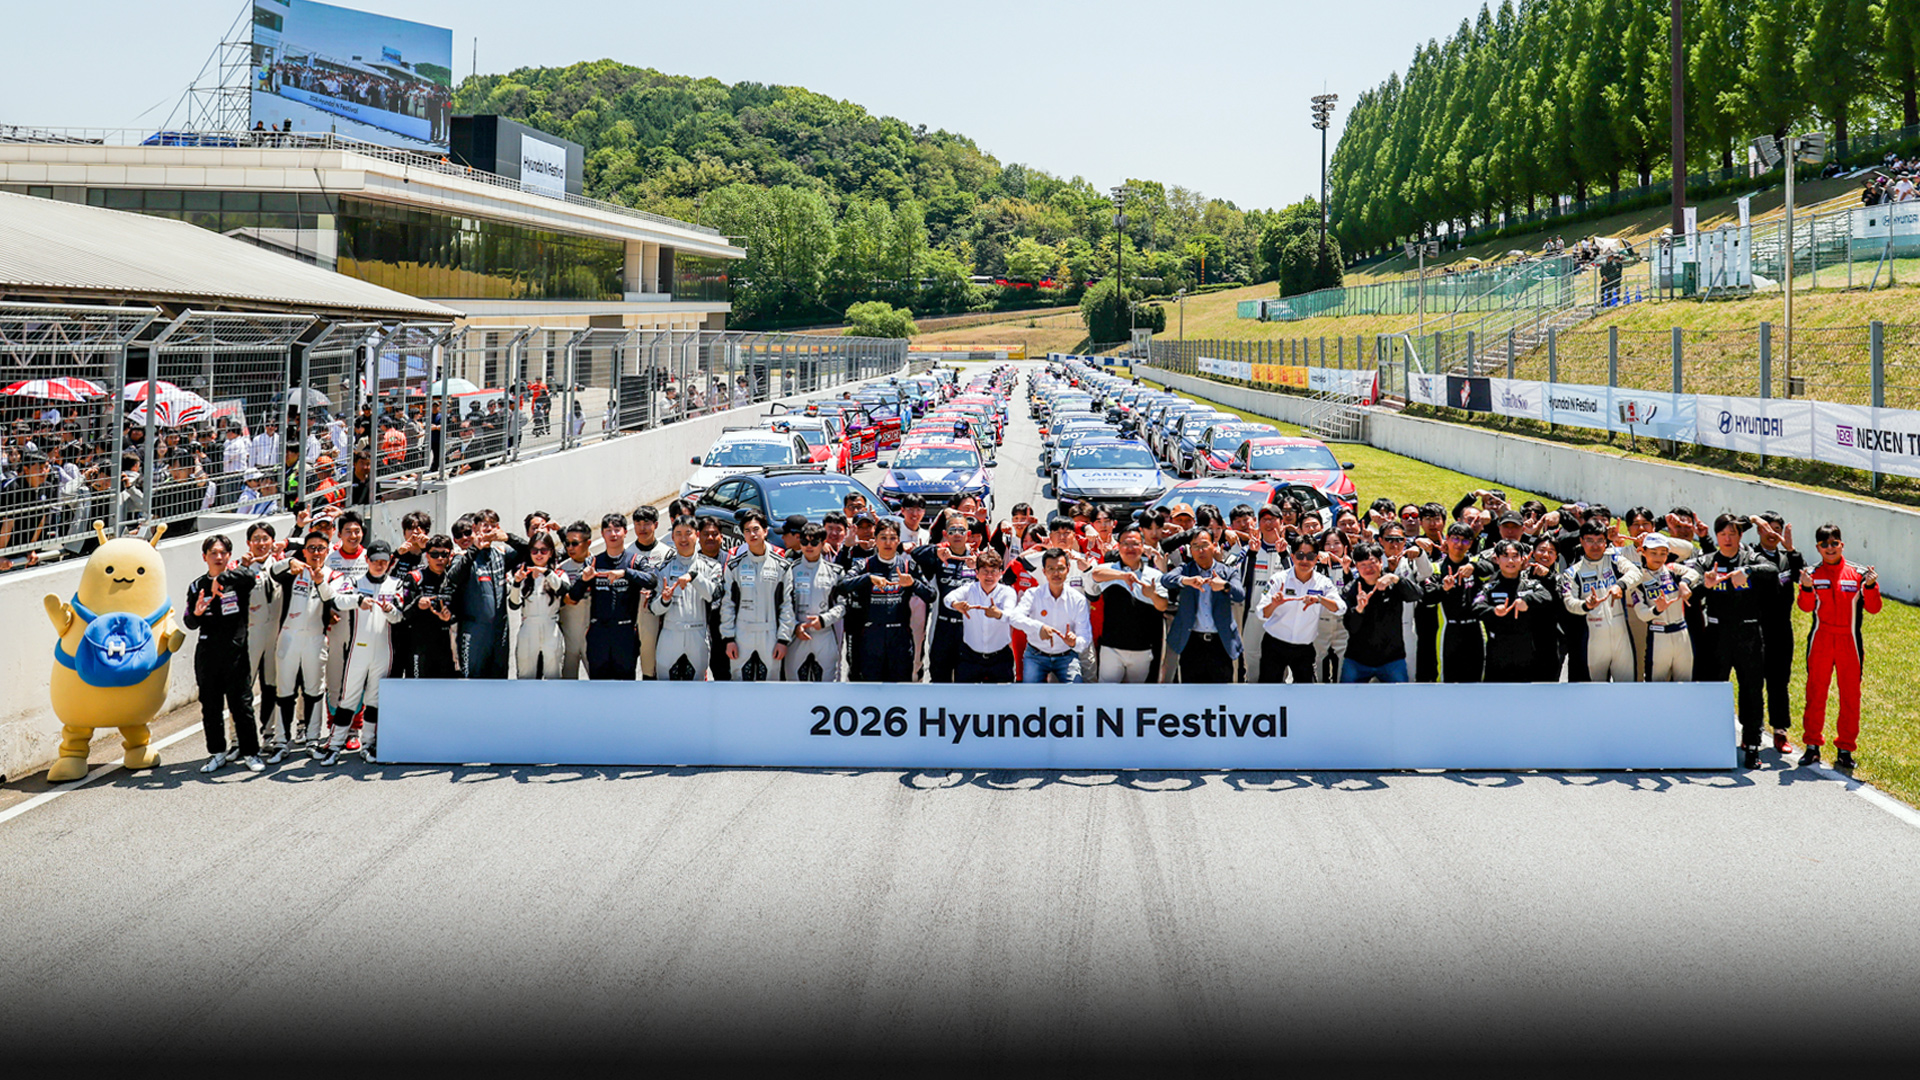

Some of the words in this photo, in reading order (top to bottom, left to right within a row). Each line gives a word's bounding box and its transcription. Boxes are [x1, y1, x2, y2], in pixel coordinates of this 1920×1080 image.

[523, 155, 544, 175] Hyundai
[1549, 396, 1570, 411] Hyundai
[1570, 399, 1576, 411] N
[1576, 398, 1597, 413] Festival
[1735, 415, 1783, 437] HYUNDAI
[1061, 432, 1087, 441] 007
[1215, 431, 1241, 439] 002
[1857, 427, 1902, 454] NEXEN
[1252, 448, 1285, 457] 006
[1219, 488, 1251, 496] Festival
[810, 705, 908, 738] 2026
[919, 705, 1084, 744] Hyundai
[1096, 707, 1124, 738] N
[1136, 705, 1288, 738] Festival
